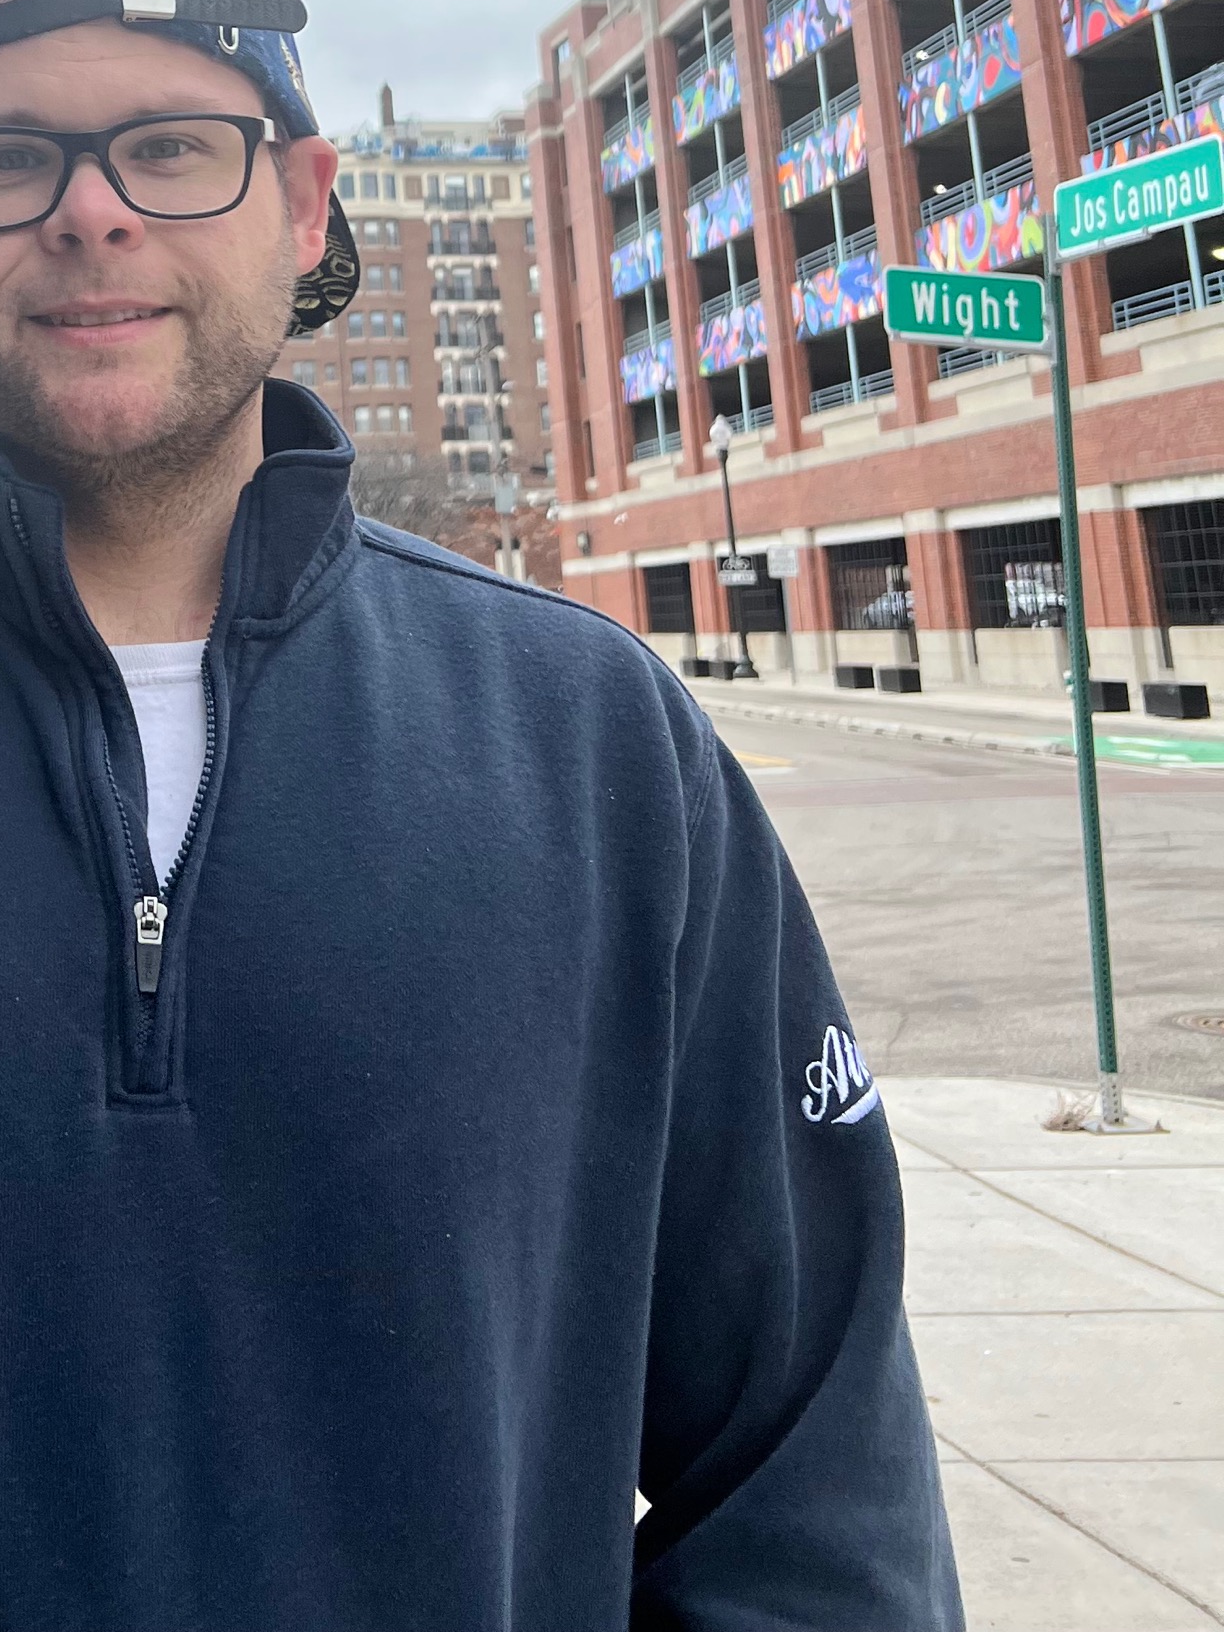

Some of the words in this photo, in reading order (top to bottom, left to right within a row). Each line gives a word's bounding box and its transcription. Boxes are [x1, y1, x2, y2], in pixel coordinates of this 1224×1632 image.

[1070, 192, 1107, 237] Jos
[1114, 164, 1210, 225] Campau
[911, 280, 1022, 336] Wight
